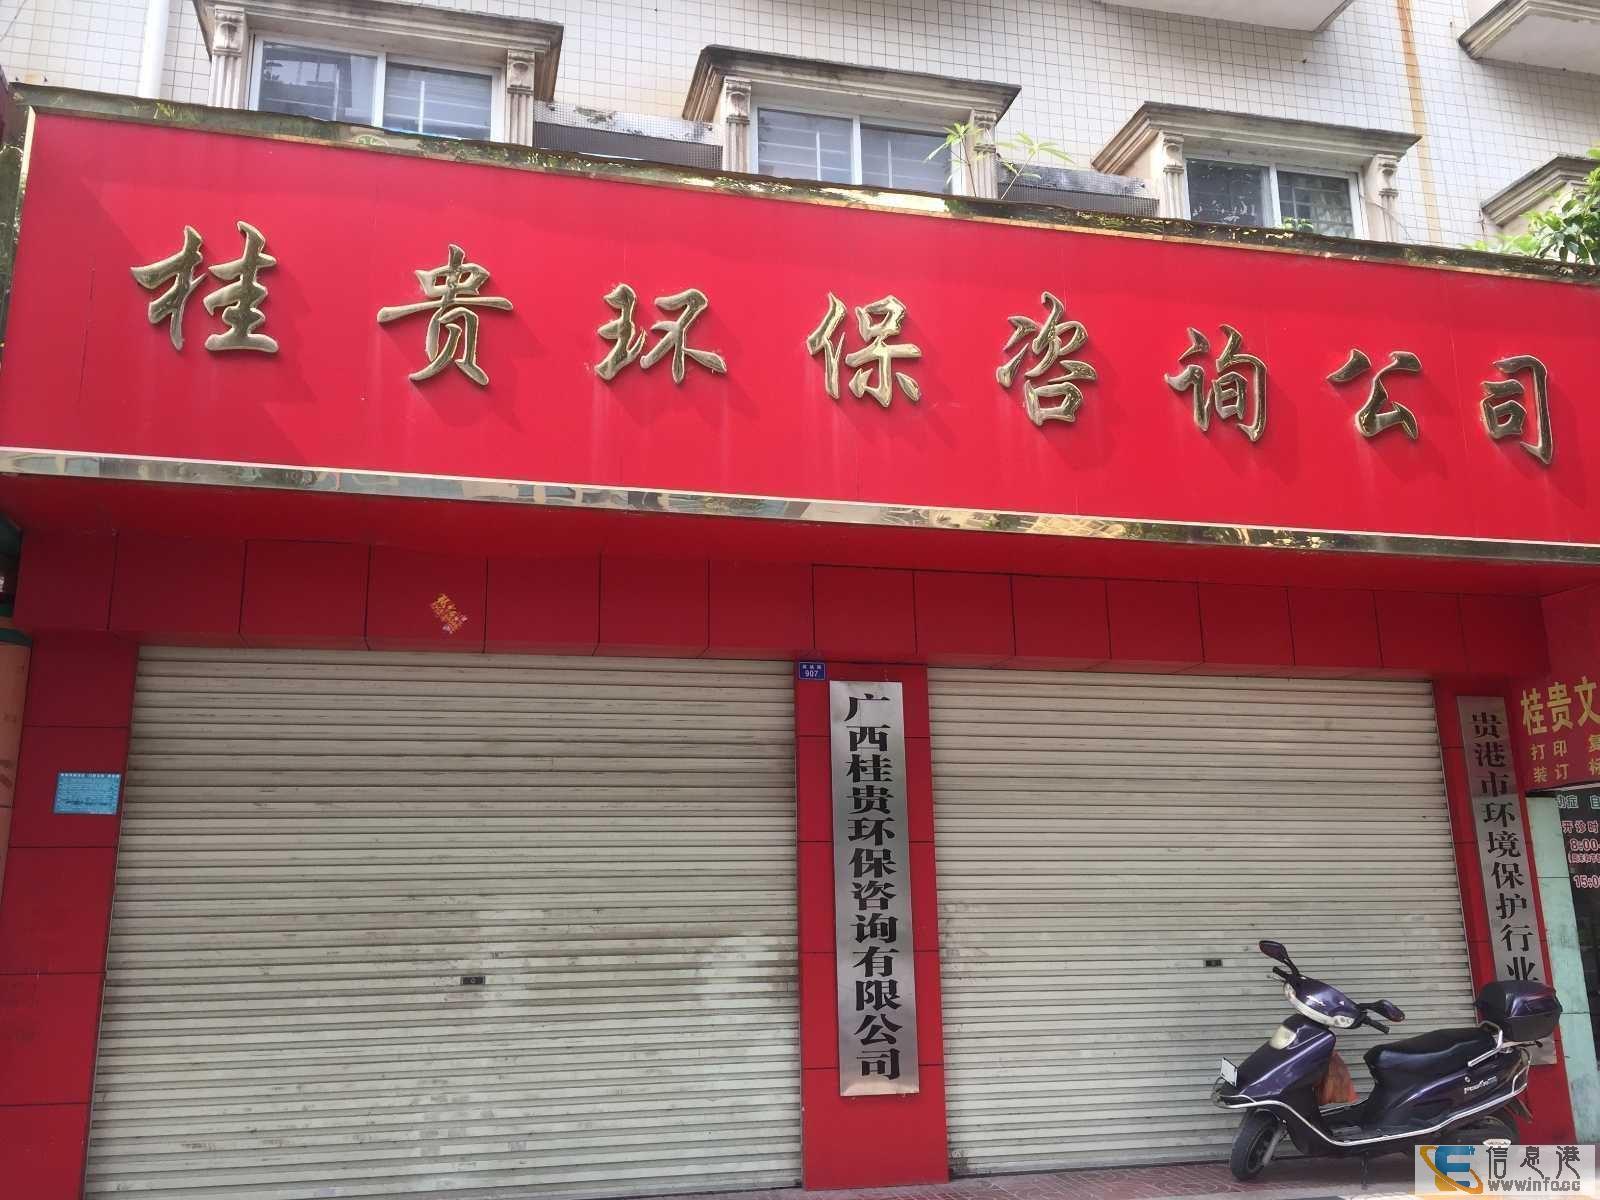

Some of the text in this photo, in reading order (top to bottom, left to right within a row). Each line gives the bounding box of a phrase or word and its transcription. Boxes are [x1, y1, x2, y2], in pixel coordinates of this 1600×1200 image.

[130, 220, 1554, 466] 桂贵环保咨询公司
[1520, 676, 1600, 736] 桂贵文
[1529, 739, 1568, 761] 打印
[1533, 763, 1569, 783] 装订
[843, 693, 902, 1080] 广西桂贵环保咨询有限公司
[1573, 874, 1600, 889] 15:0
